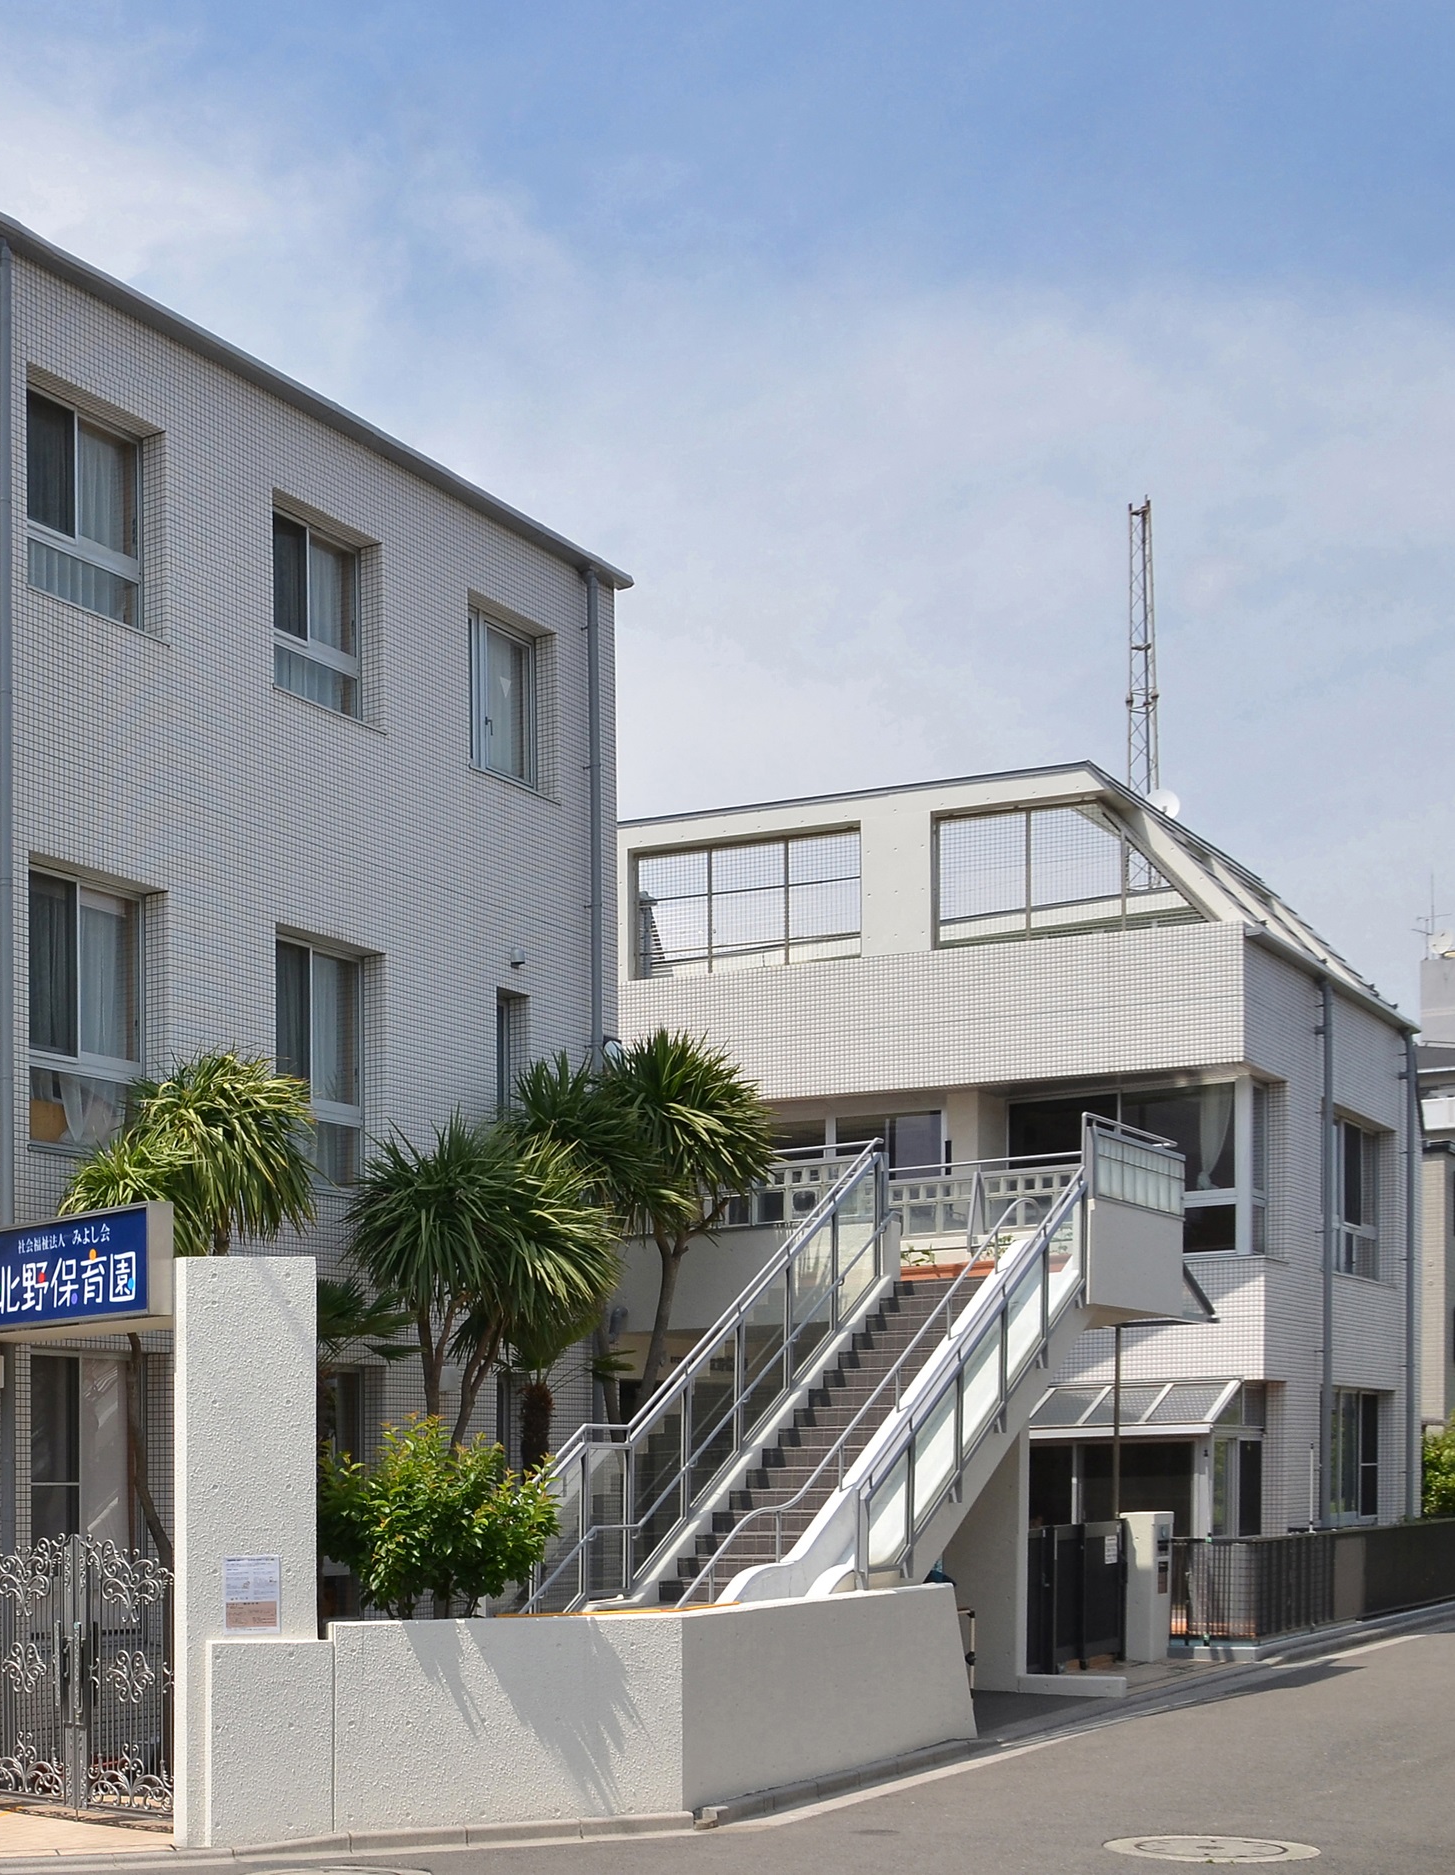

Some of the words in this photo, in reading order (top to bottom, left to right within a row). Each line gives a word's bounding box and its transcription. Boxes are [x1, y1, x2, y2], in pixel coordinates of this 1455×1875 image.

[18, 1233, 66, 1254] 社会福祉法人
[72, 1223, 111, 1245] みよし会
